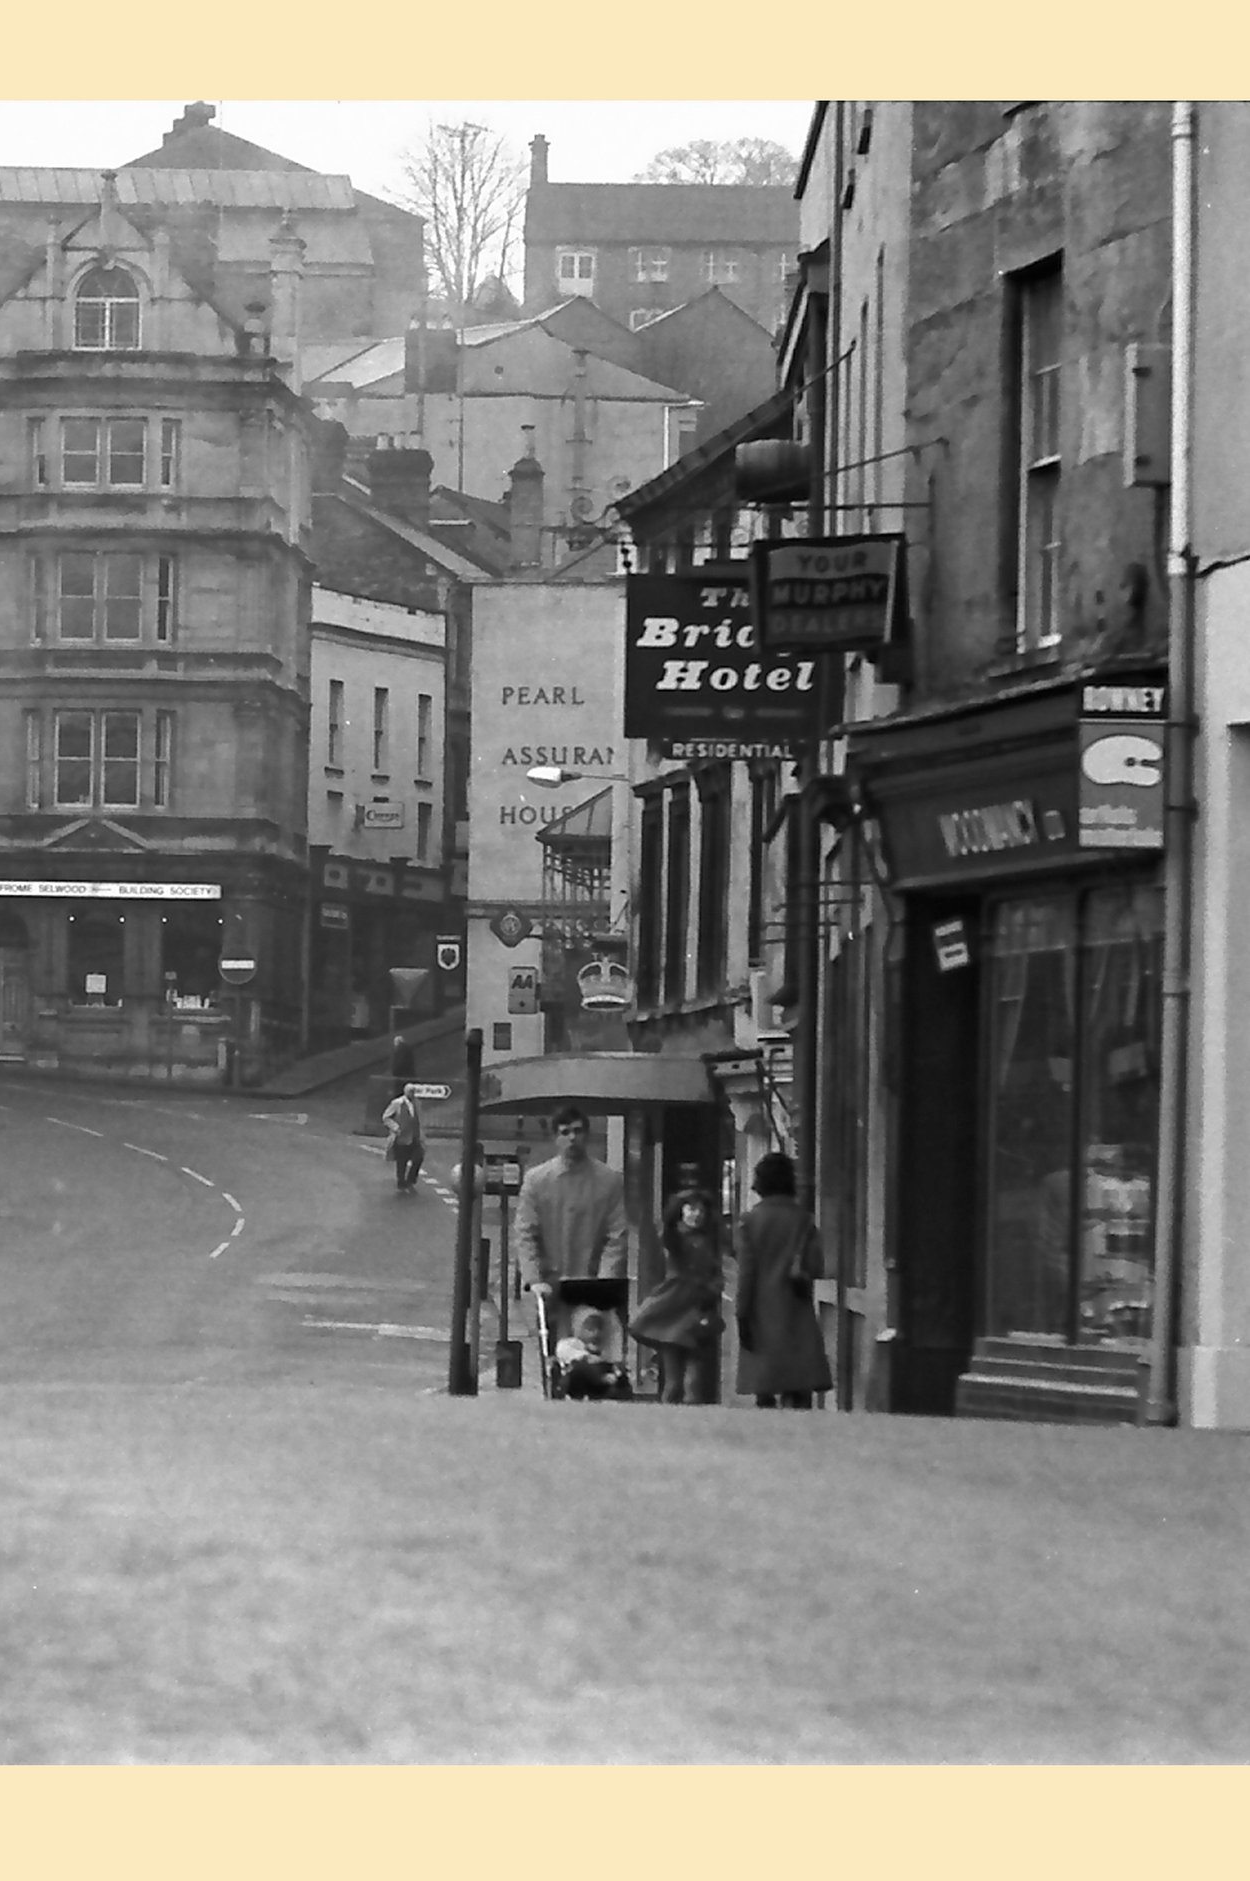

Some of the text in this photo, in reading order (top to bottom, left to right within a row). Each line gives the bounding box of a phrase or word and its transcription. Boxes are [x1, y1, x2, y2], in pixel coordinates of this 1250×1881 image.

[800, 551, 868, 573] YOUR
[700, 587, 750, 607] Th
[771, 580, 883, 605] MURPHY
[655, 660, 816, 691] Hotel
[502, 686, 586, 706] PEARL
[671, 742, 795, 759] RESIDENTIAL
[39, 884, 87, 893] SELWOOD
[119, 886, 165, 895] BUILDING
[511, 974, 533, 990] AA
